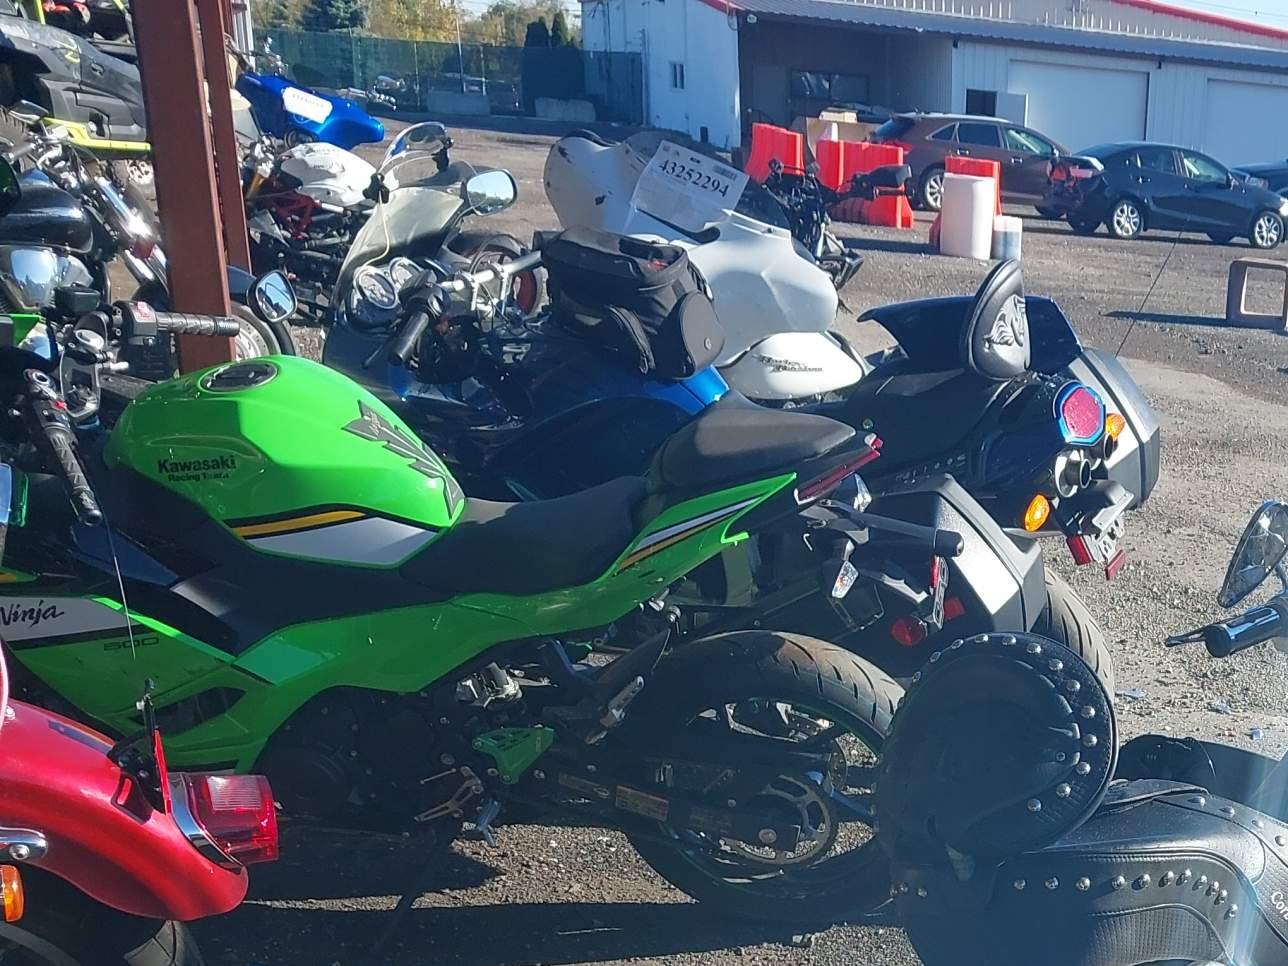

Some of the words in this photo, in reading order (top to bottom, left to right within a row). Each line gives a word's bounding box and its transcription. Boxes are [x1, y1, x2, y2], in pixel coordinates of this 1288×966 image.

[659, 159, 729, 197] 43252294
[157, 455, 237, 474] Kawasaki
[0, 600, 65, 628] Ninja
